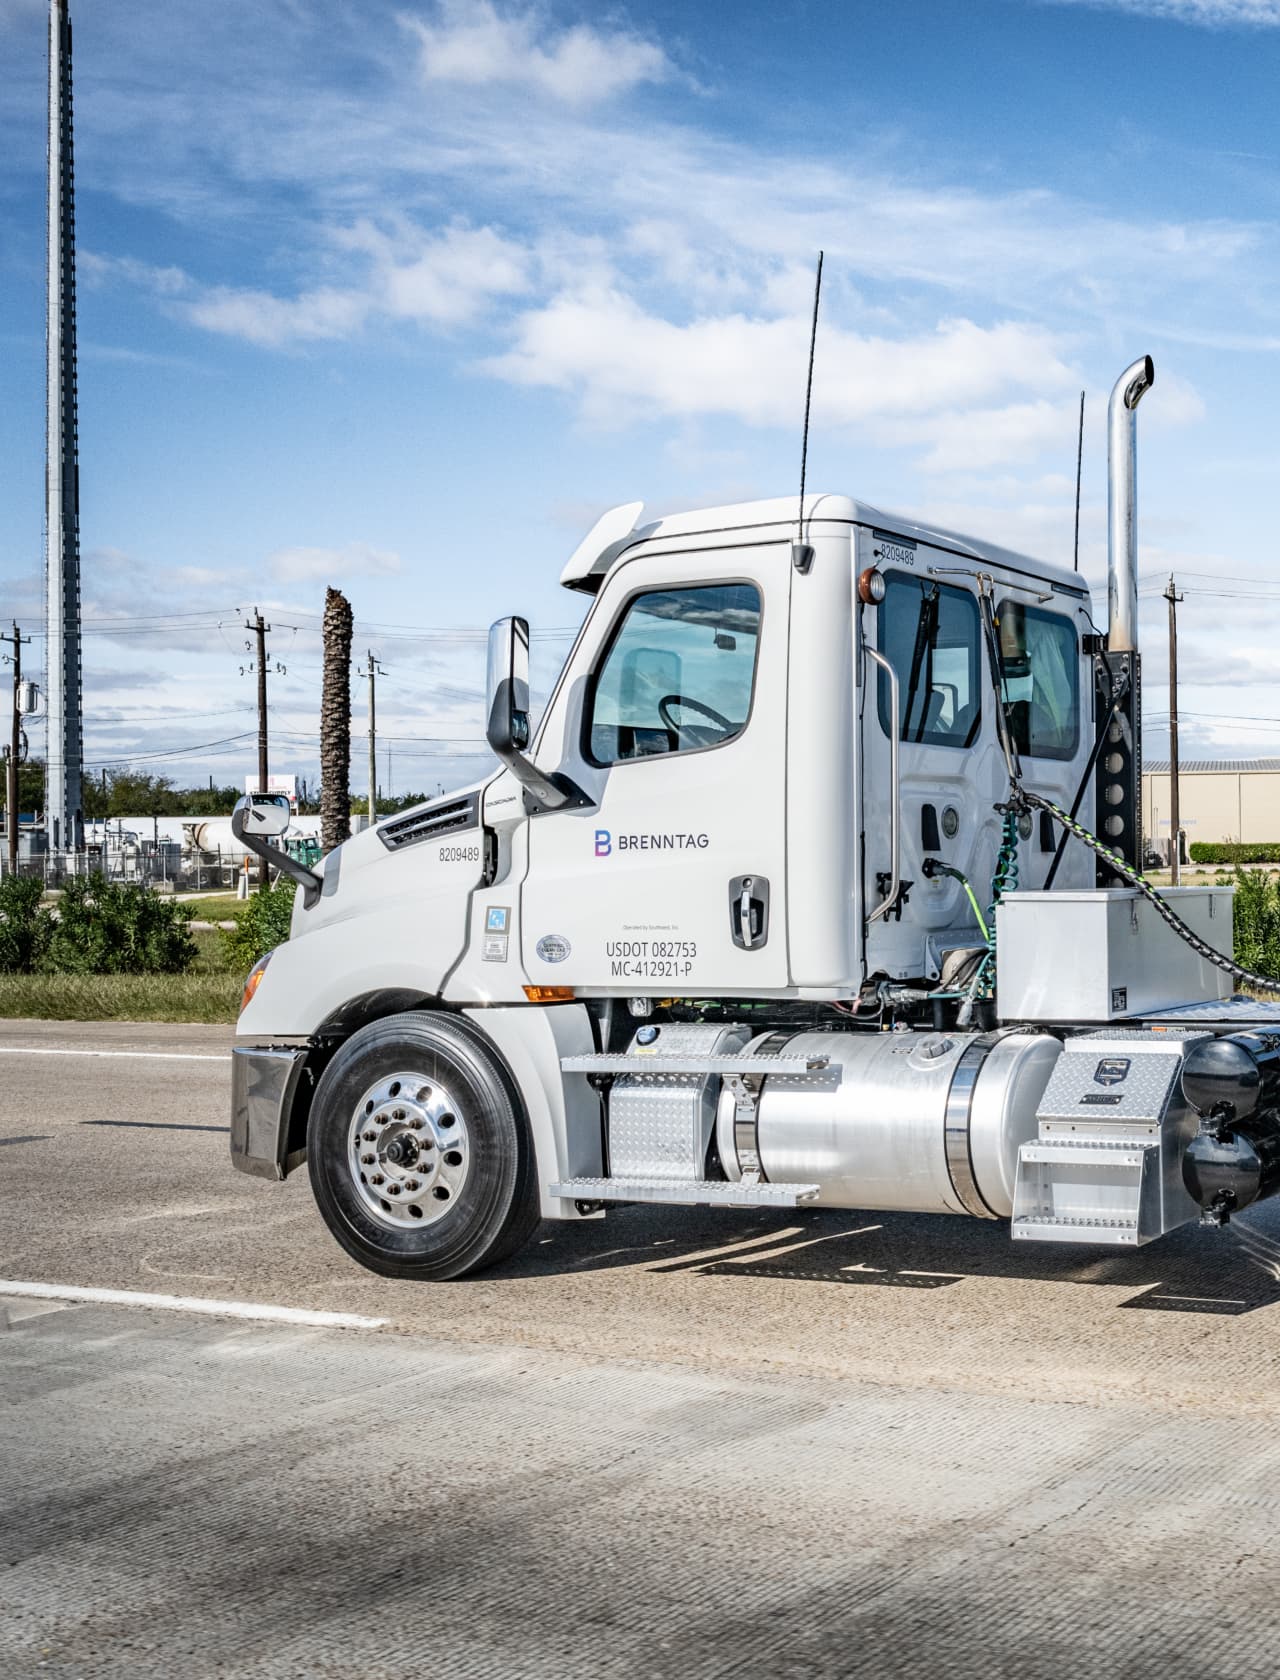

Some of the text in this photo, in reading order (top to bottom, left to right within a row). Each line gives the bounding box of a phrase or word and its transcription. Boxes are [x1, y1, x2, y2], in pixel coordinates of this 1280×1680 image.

[881, 543, 914, 566] 8209489
[619, 834, 710, 850] BRENNTAG
[440, 847, 480, 862] 8209489
[606, 942, 697, 957] USDOT 082753
[611, 961, 692, 976] MC-412921-P
